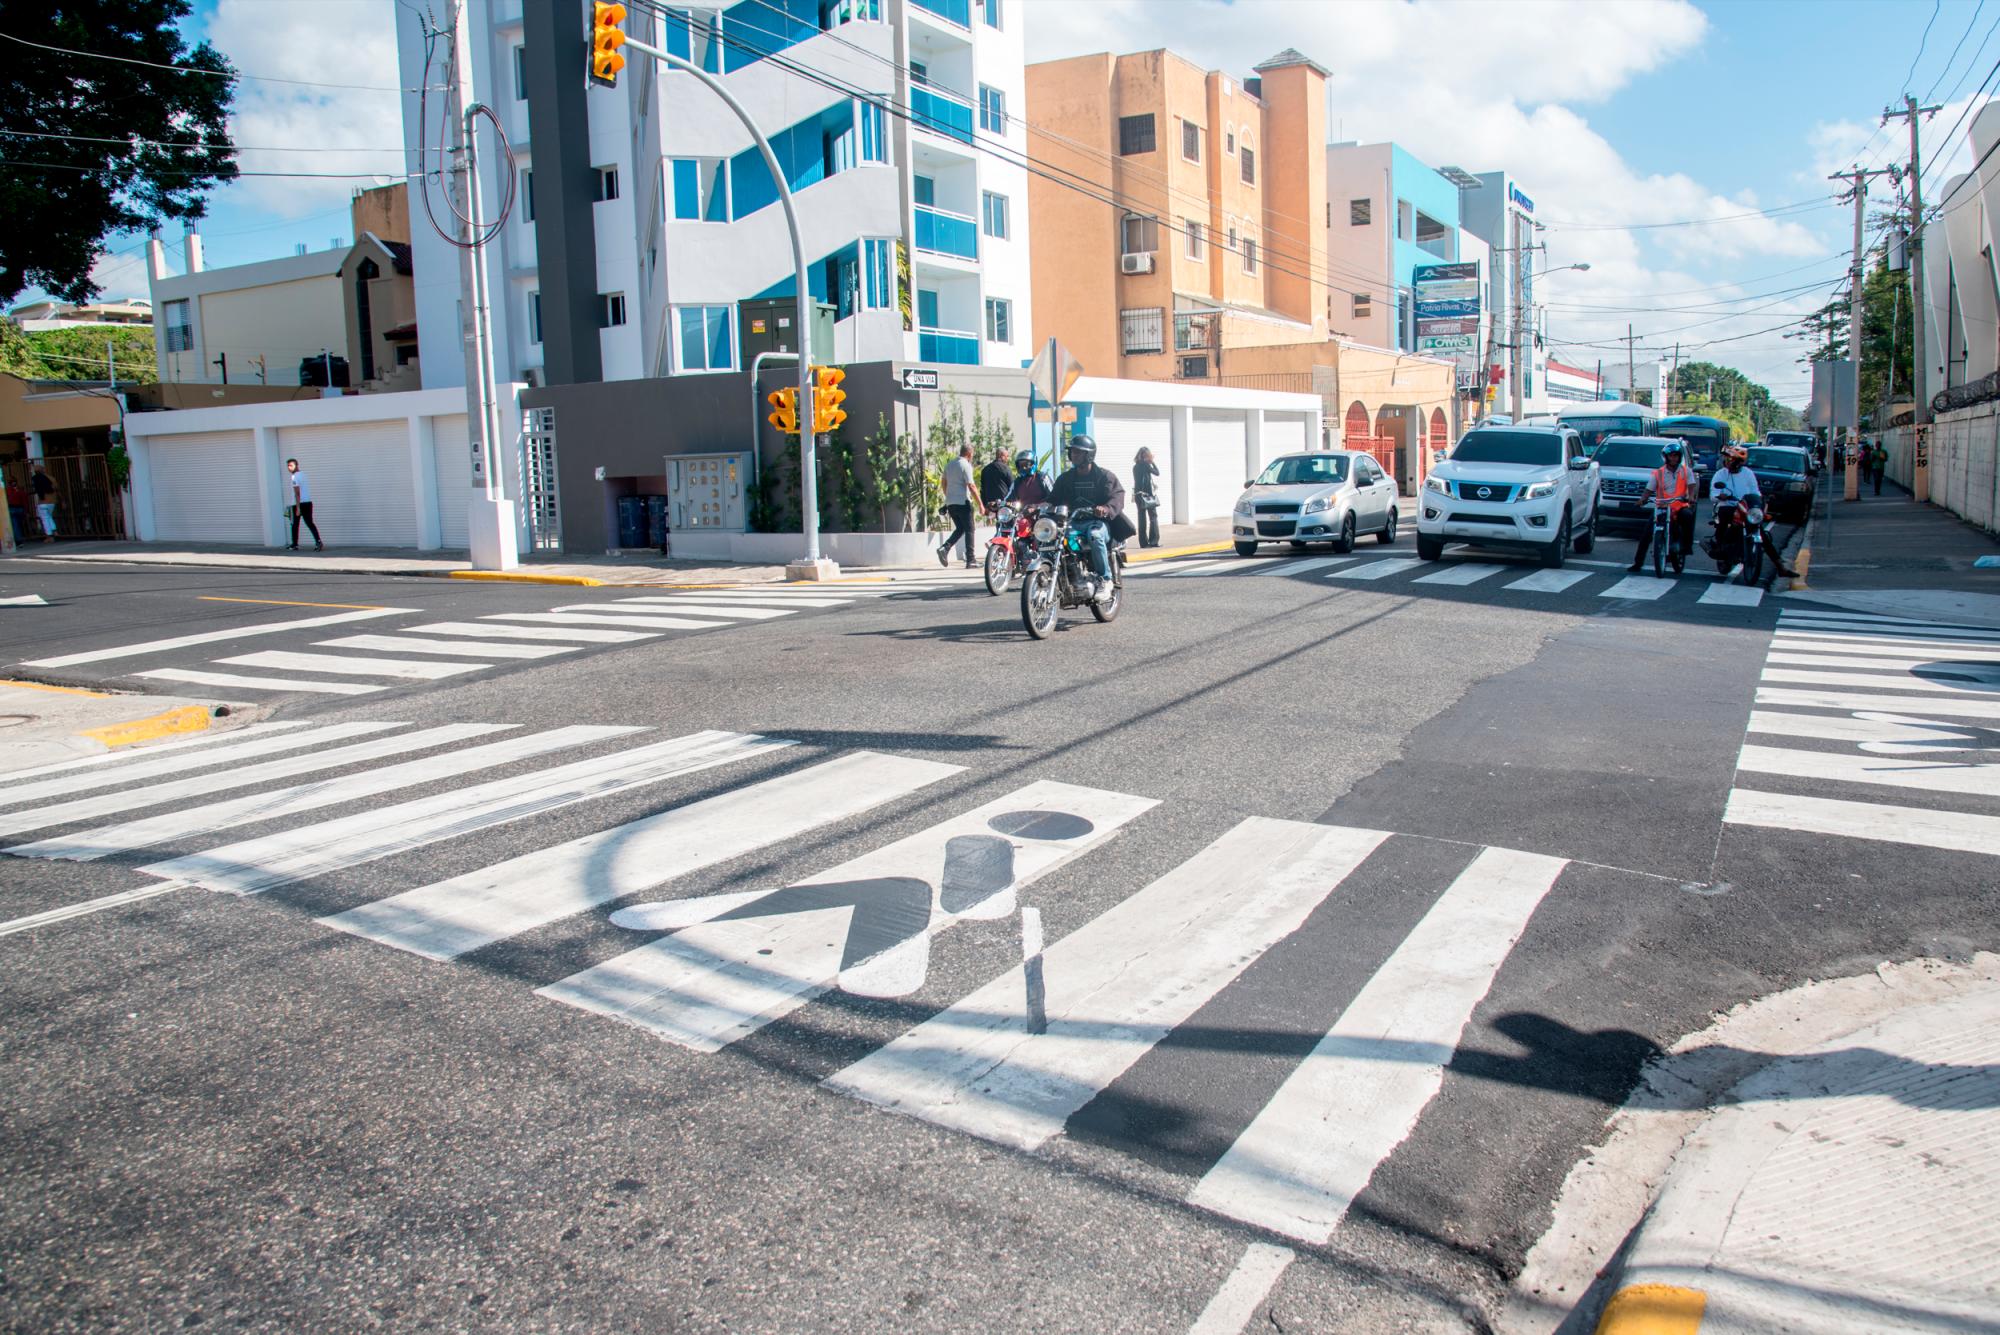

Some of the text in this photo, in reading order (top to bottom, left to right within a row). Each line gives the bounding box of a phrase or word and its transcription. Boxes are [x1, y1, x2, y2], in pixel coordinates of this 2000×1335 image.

[913, 375, 935, 383] UNA VIA
[1917, 458, 1928, 468] 19
